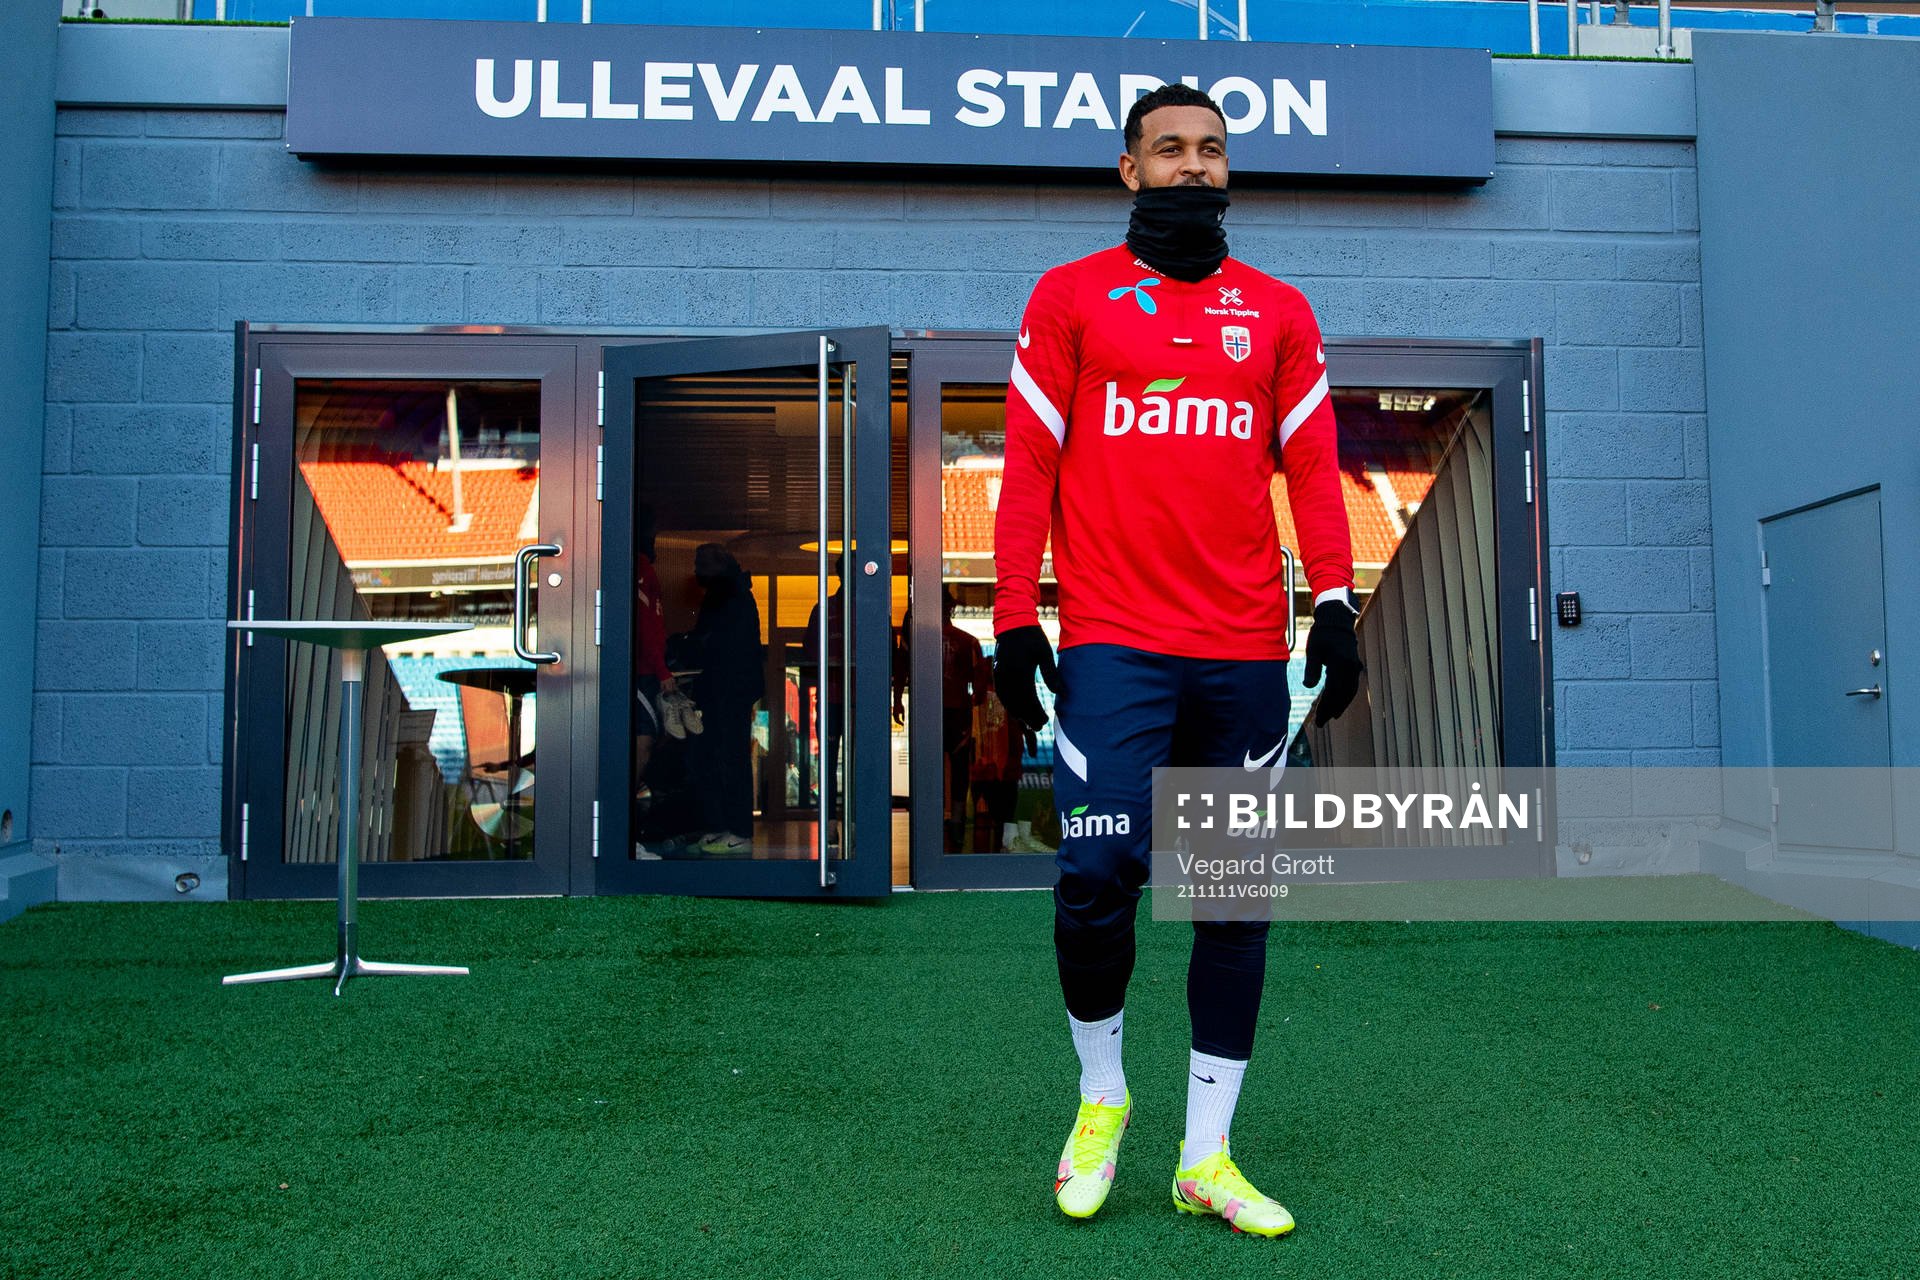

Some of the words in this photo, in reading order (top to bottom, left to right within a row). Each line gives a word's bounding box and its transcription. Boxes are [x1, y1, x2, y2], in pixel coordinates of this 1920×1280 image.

[475, 58, 931, 125] ULLEVAAL
[1204, 307, 1229, 315] Norsk
[1229, 308, 1260, 318] Tipping
[1103, 381, 1254, 440] bama
[1061, 810, 1130, 840] bama
